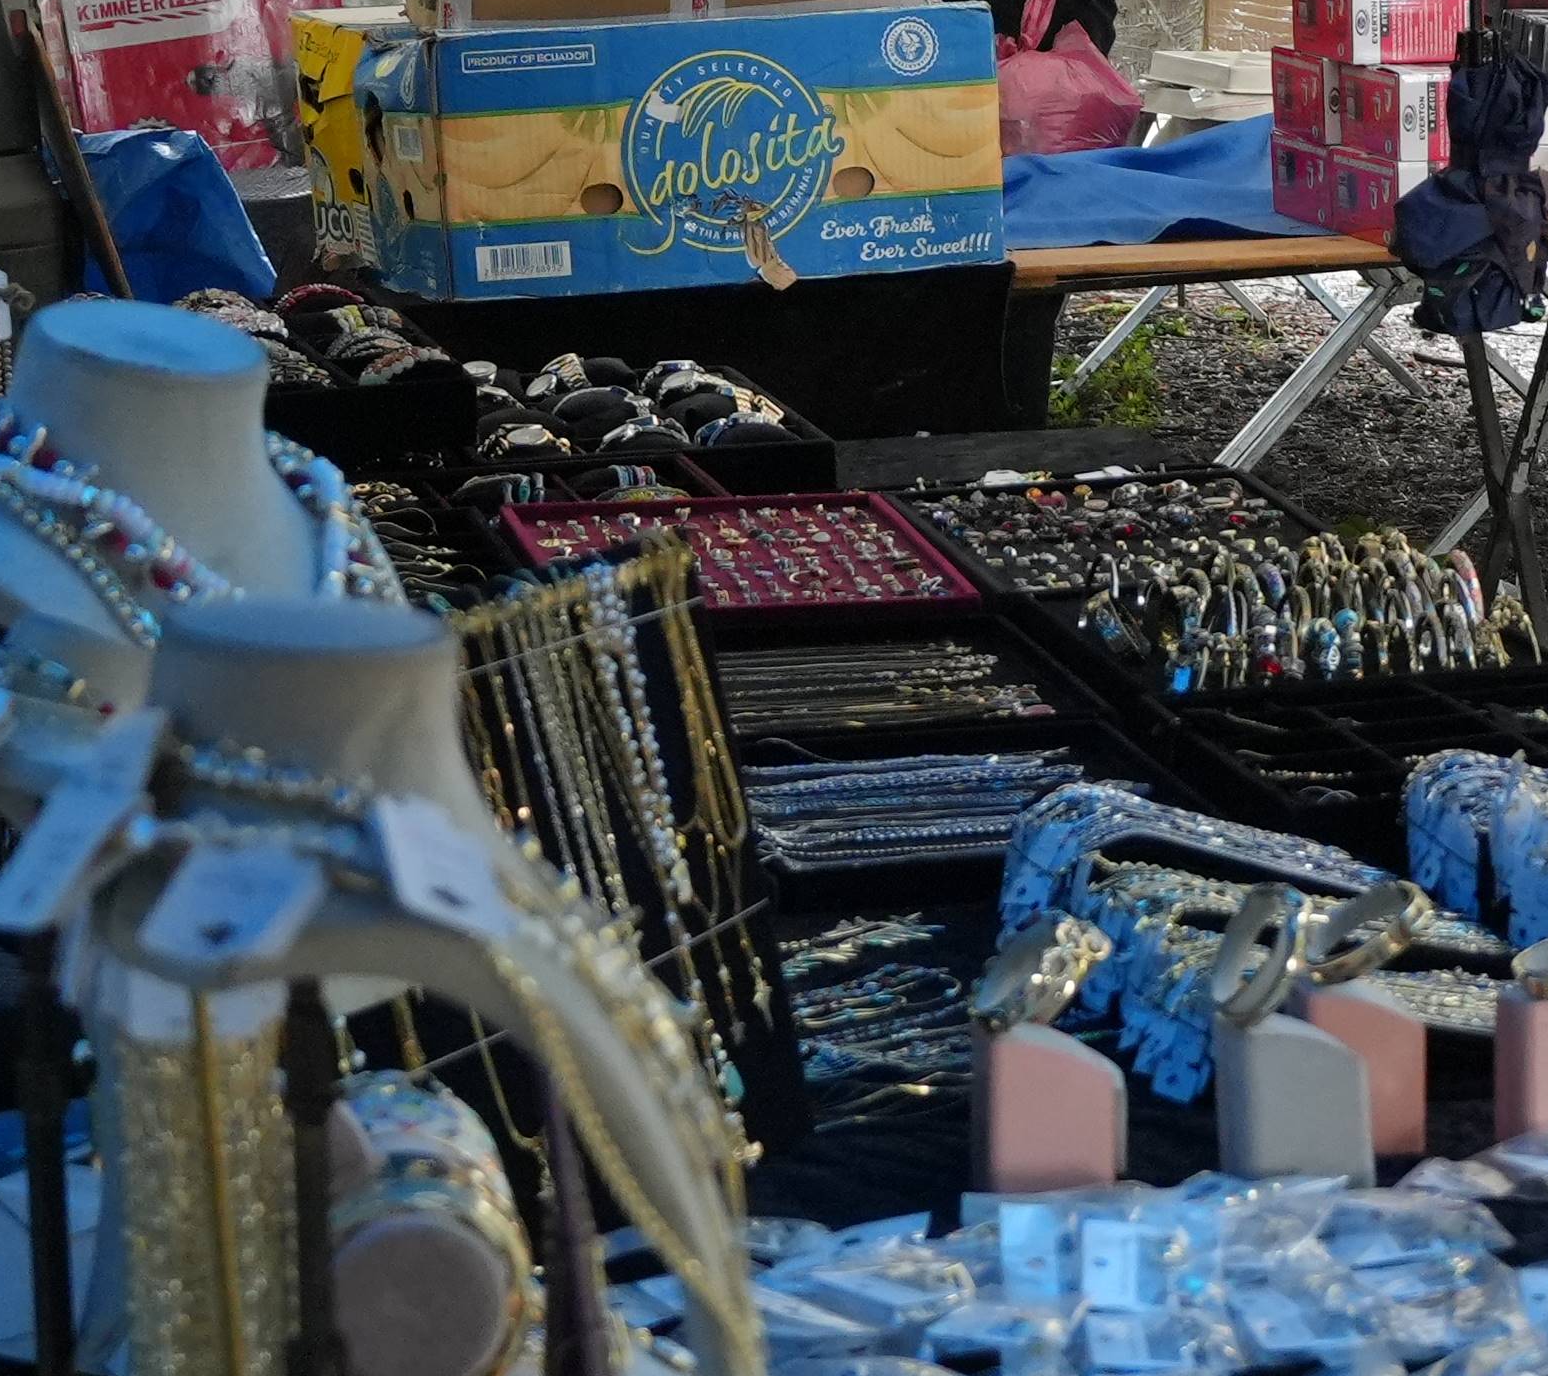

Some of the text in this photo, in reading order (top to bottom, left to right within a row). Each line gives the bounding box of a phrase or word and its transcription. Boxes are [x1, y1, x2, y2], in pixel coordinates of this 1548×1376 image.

[467, 50, 589, 67] PRODUCT OF ECUADOR
[697, 61, 793, 98] SELECTED
[1418, 95, 1426, 141] EVERTON
[778, 167, 813, 219] BANANAS
[820, 214, 936, 240] Ever Fresh,
[860, 232, 993, 262] Ever Sweet!!!
